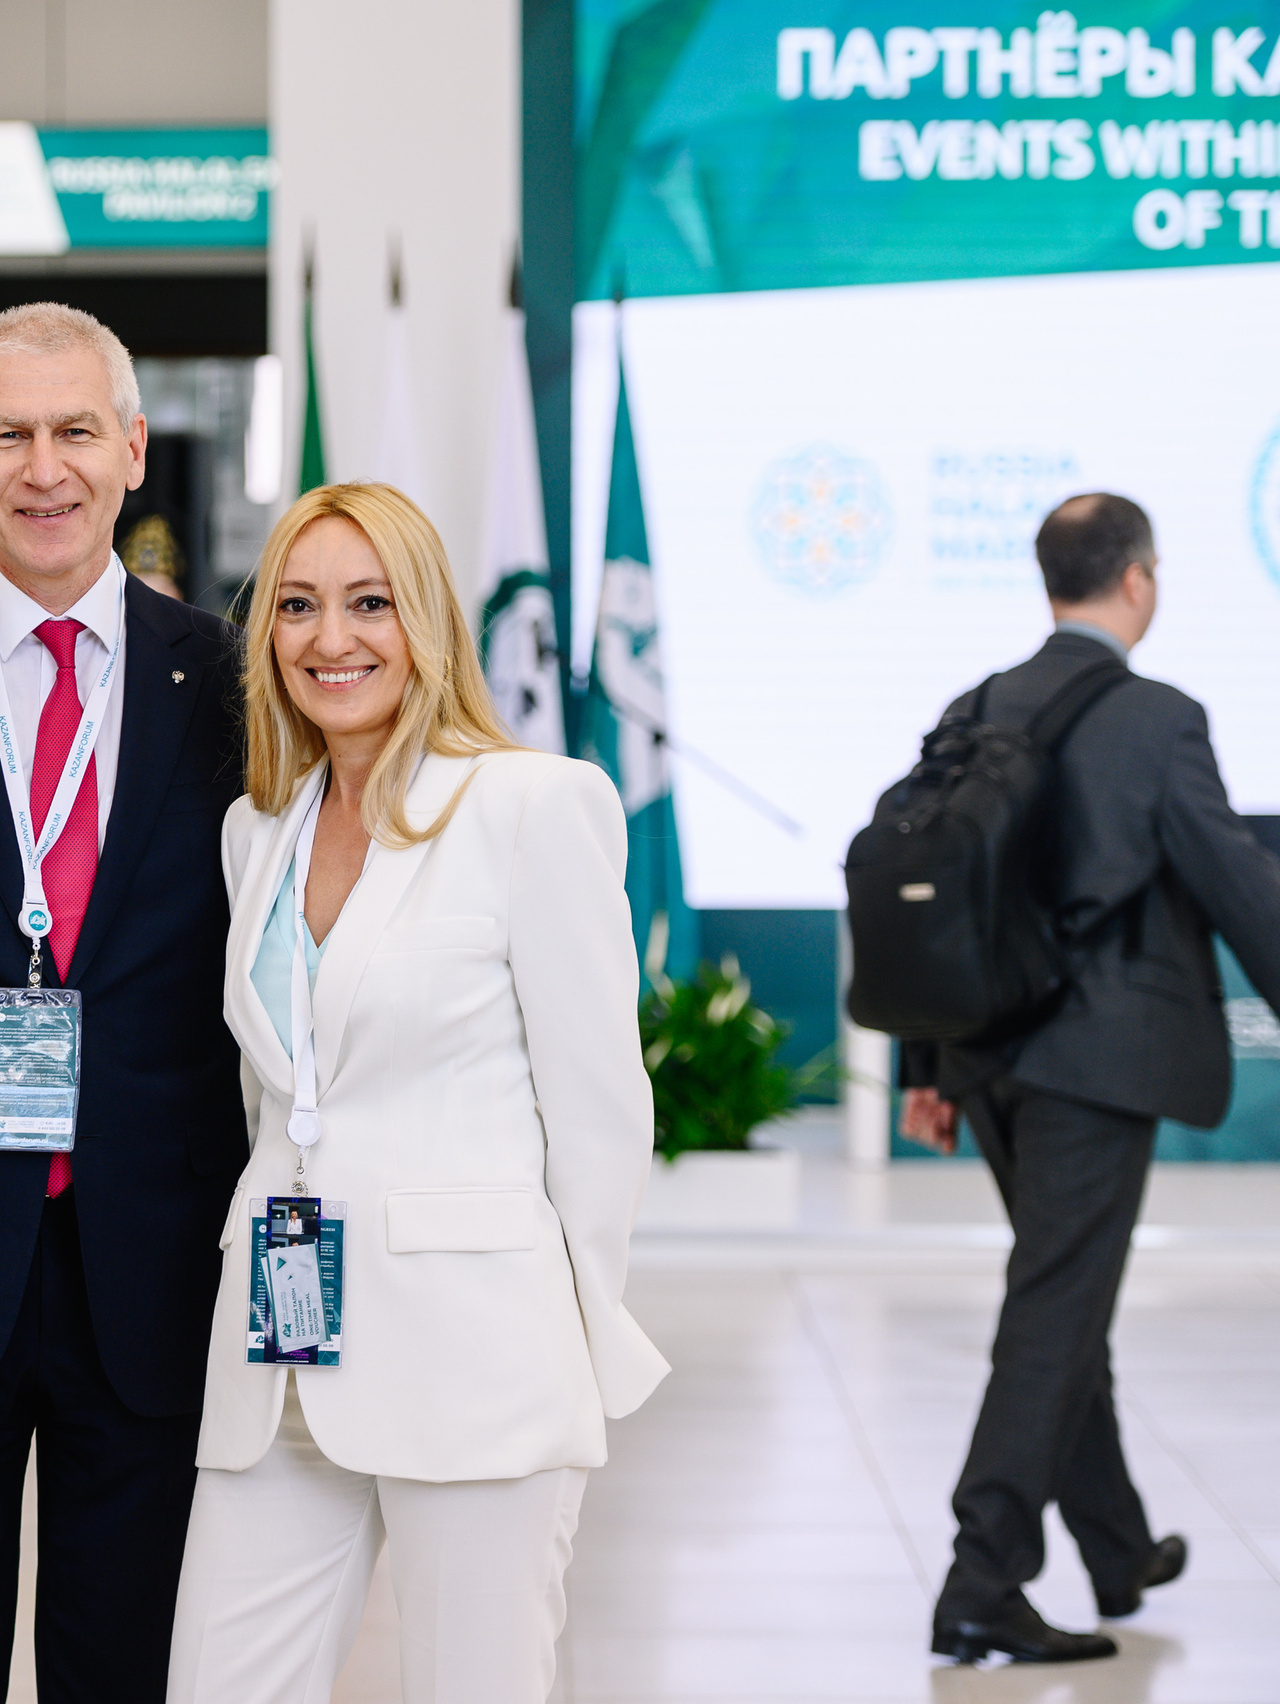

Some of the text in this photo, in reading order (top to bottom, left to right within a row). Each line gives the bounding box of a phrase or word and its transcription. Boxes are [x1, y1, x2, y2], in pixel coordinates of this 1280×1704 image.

[776, 10, 1196, 100] ПАРТНЁРЫ
[858, 119, 1280, 181] EVENTS WITHI
[1132, 188, 1223, 250] OF
[68, 720, 95, 778] KAZANFORUM
[32, 813, 62, 870] KAZANFORUM
[292, 1308, 301, 1337] РАЗОВЫЙ
[312, 1308, 320, 1335] VOUCHER
